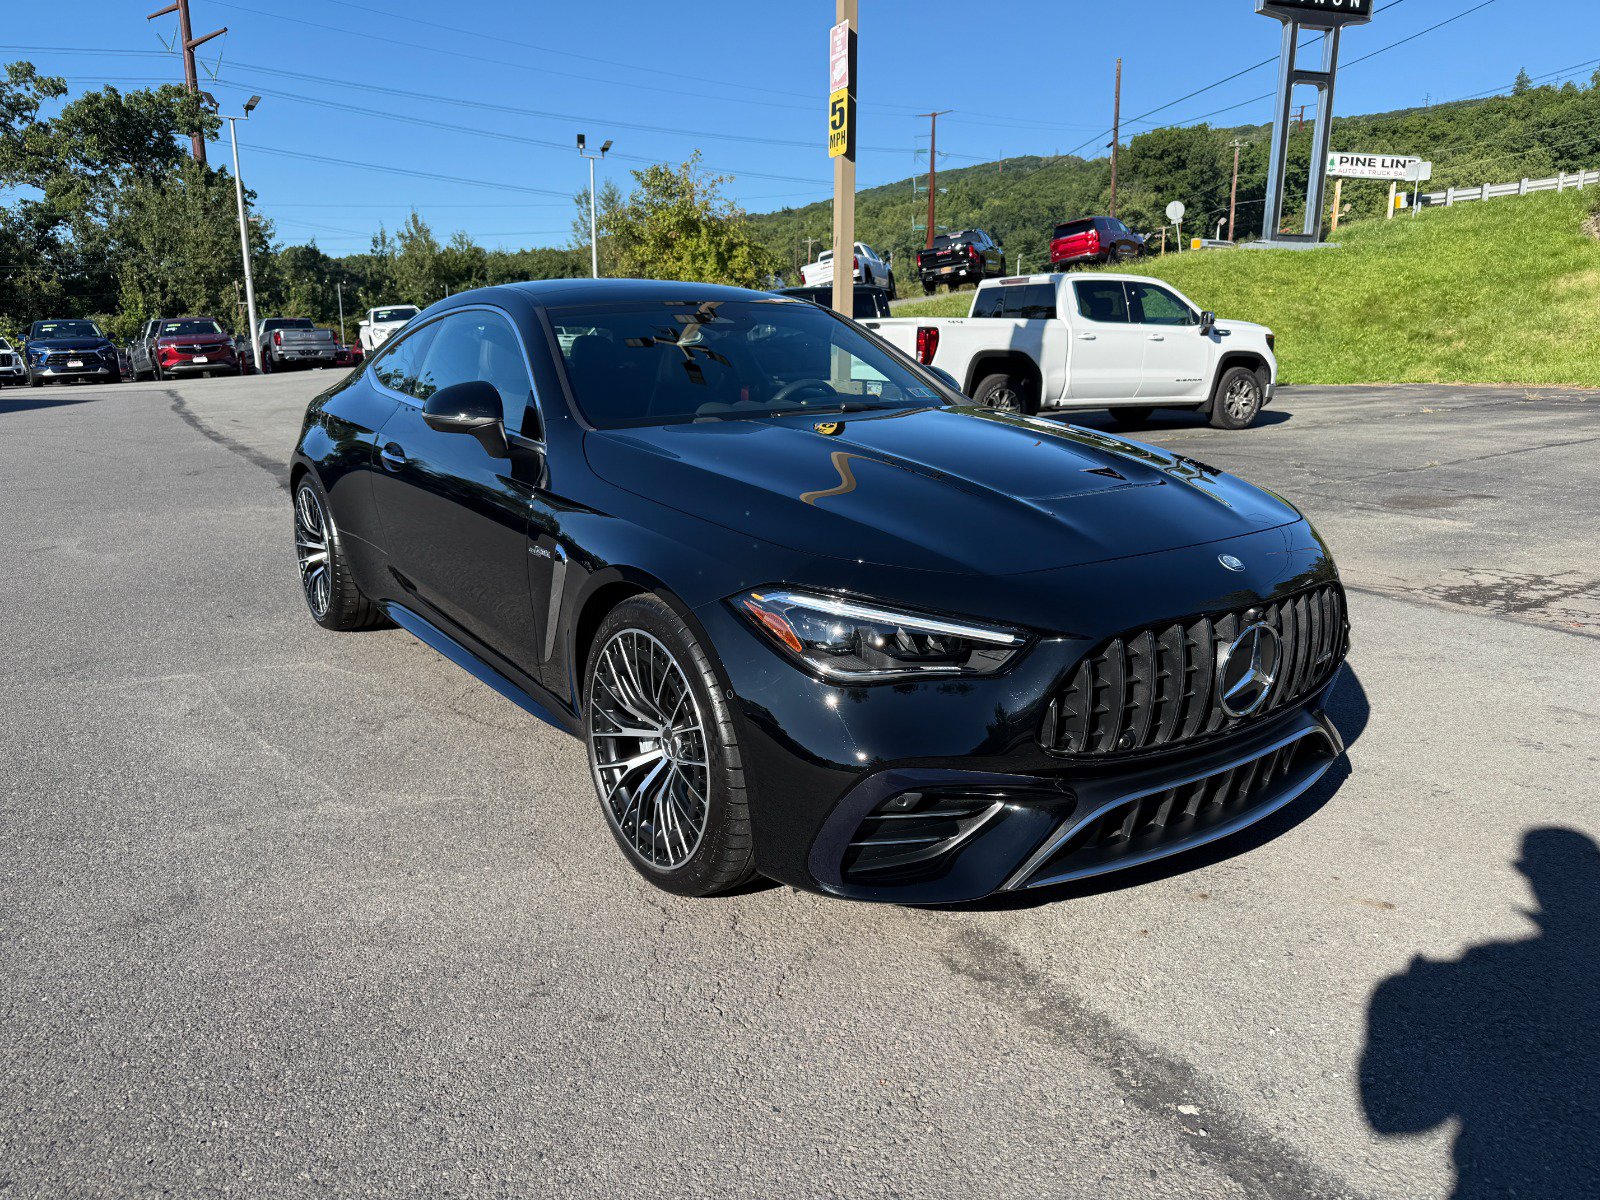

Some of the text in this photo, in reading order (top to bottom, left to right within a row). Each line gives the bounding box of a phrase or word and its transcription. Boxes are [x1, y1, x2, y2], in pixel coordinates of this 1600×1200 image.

[831, 98, 845, 130] 5
[830, 130, 846, 149] MPH
[1339, 156, 1377, 167] PINE
